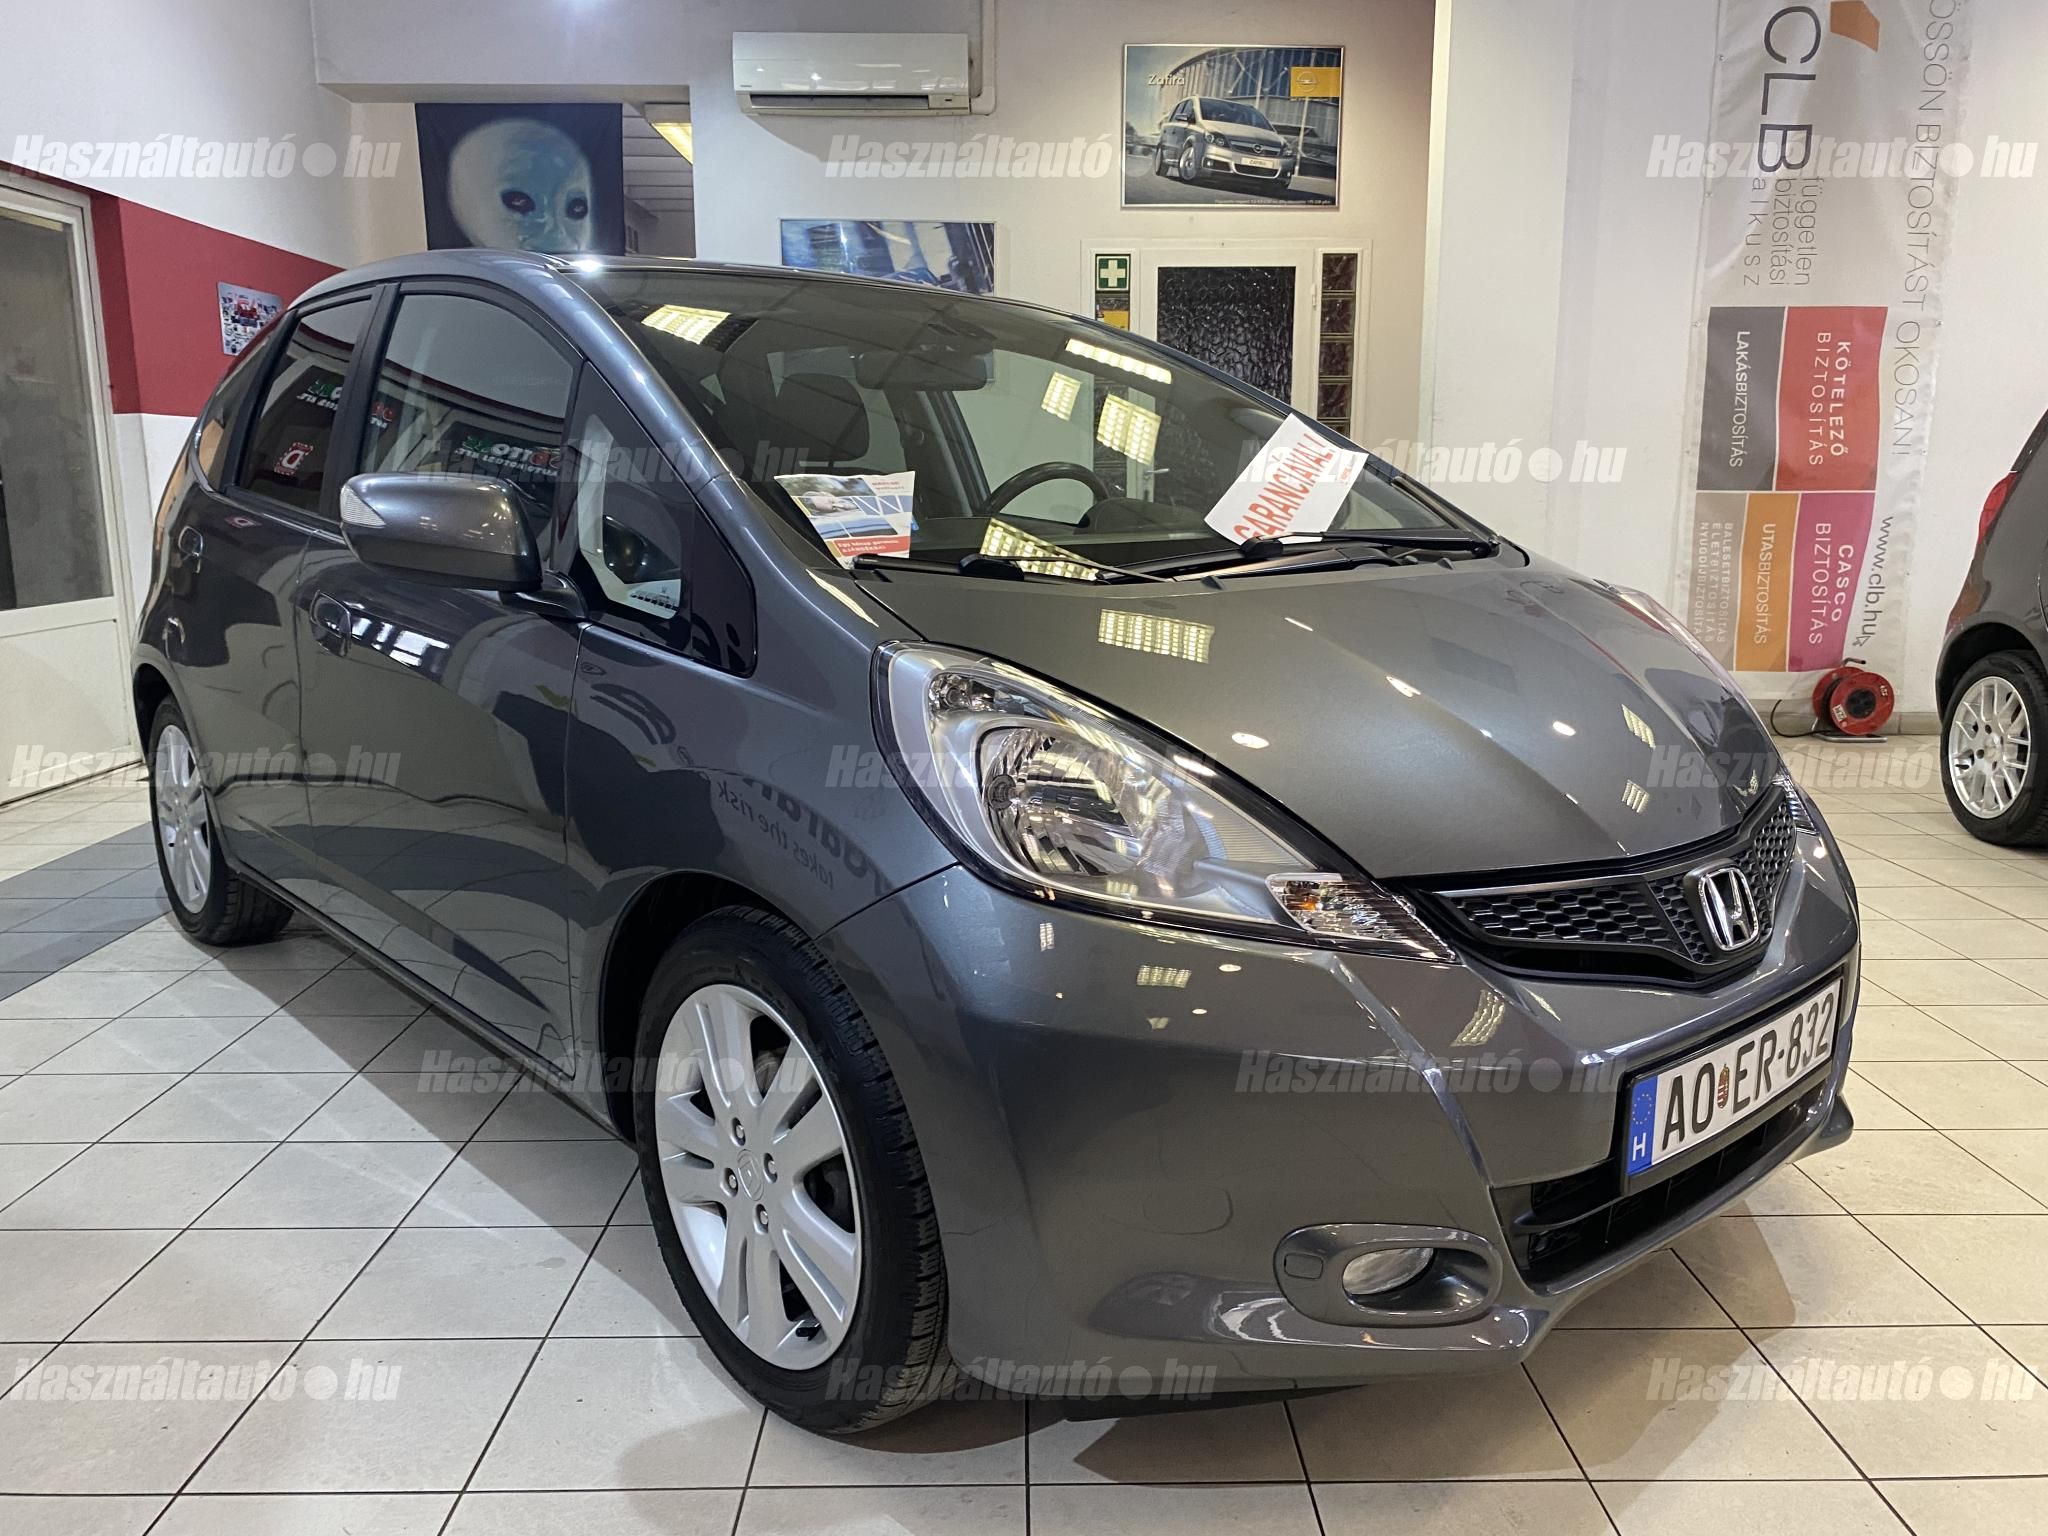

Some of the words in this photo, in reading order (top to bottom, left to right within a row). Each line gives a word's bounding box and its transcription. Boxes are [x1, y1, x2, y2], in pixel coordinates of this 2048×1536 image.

[1148, 74, 1185, 86] Zafira
[1756, 5, 1822, 173] CLB
[1744, 177, 1768, 286] alkusz
[1769, 177, 1797, 286] biztosítási
[1793, 177, 1824, 286] független
[1902, 123, 1941, 311] BIZTOSÍTÁST
[1729, 331, 1750, 467] LAKÁSBIZTOSÍTÁS
[1809, 332, 1831, 466] BIZTOSÍTÁS
[1830, 341, 1850, 457] KÖTELEZŐ
[1892, 320, 1921, 456] OKOSAN!
[1755, 523, 1776, 644] UTASBIZTOSÍTÁS
[1808, 523, 1832, 644] BIZTOSÍTÁS
[1831, 544, 1854, 622] CASCO
[1862, 516, 1893, 637] www.clb.hu
[1632, 1132, 1647, 1161] H
